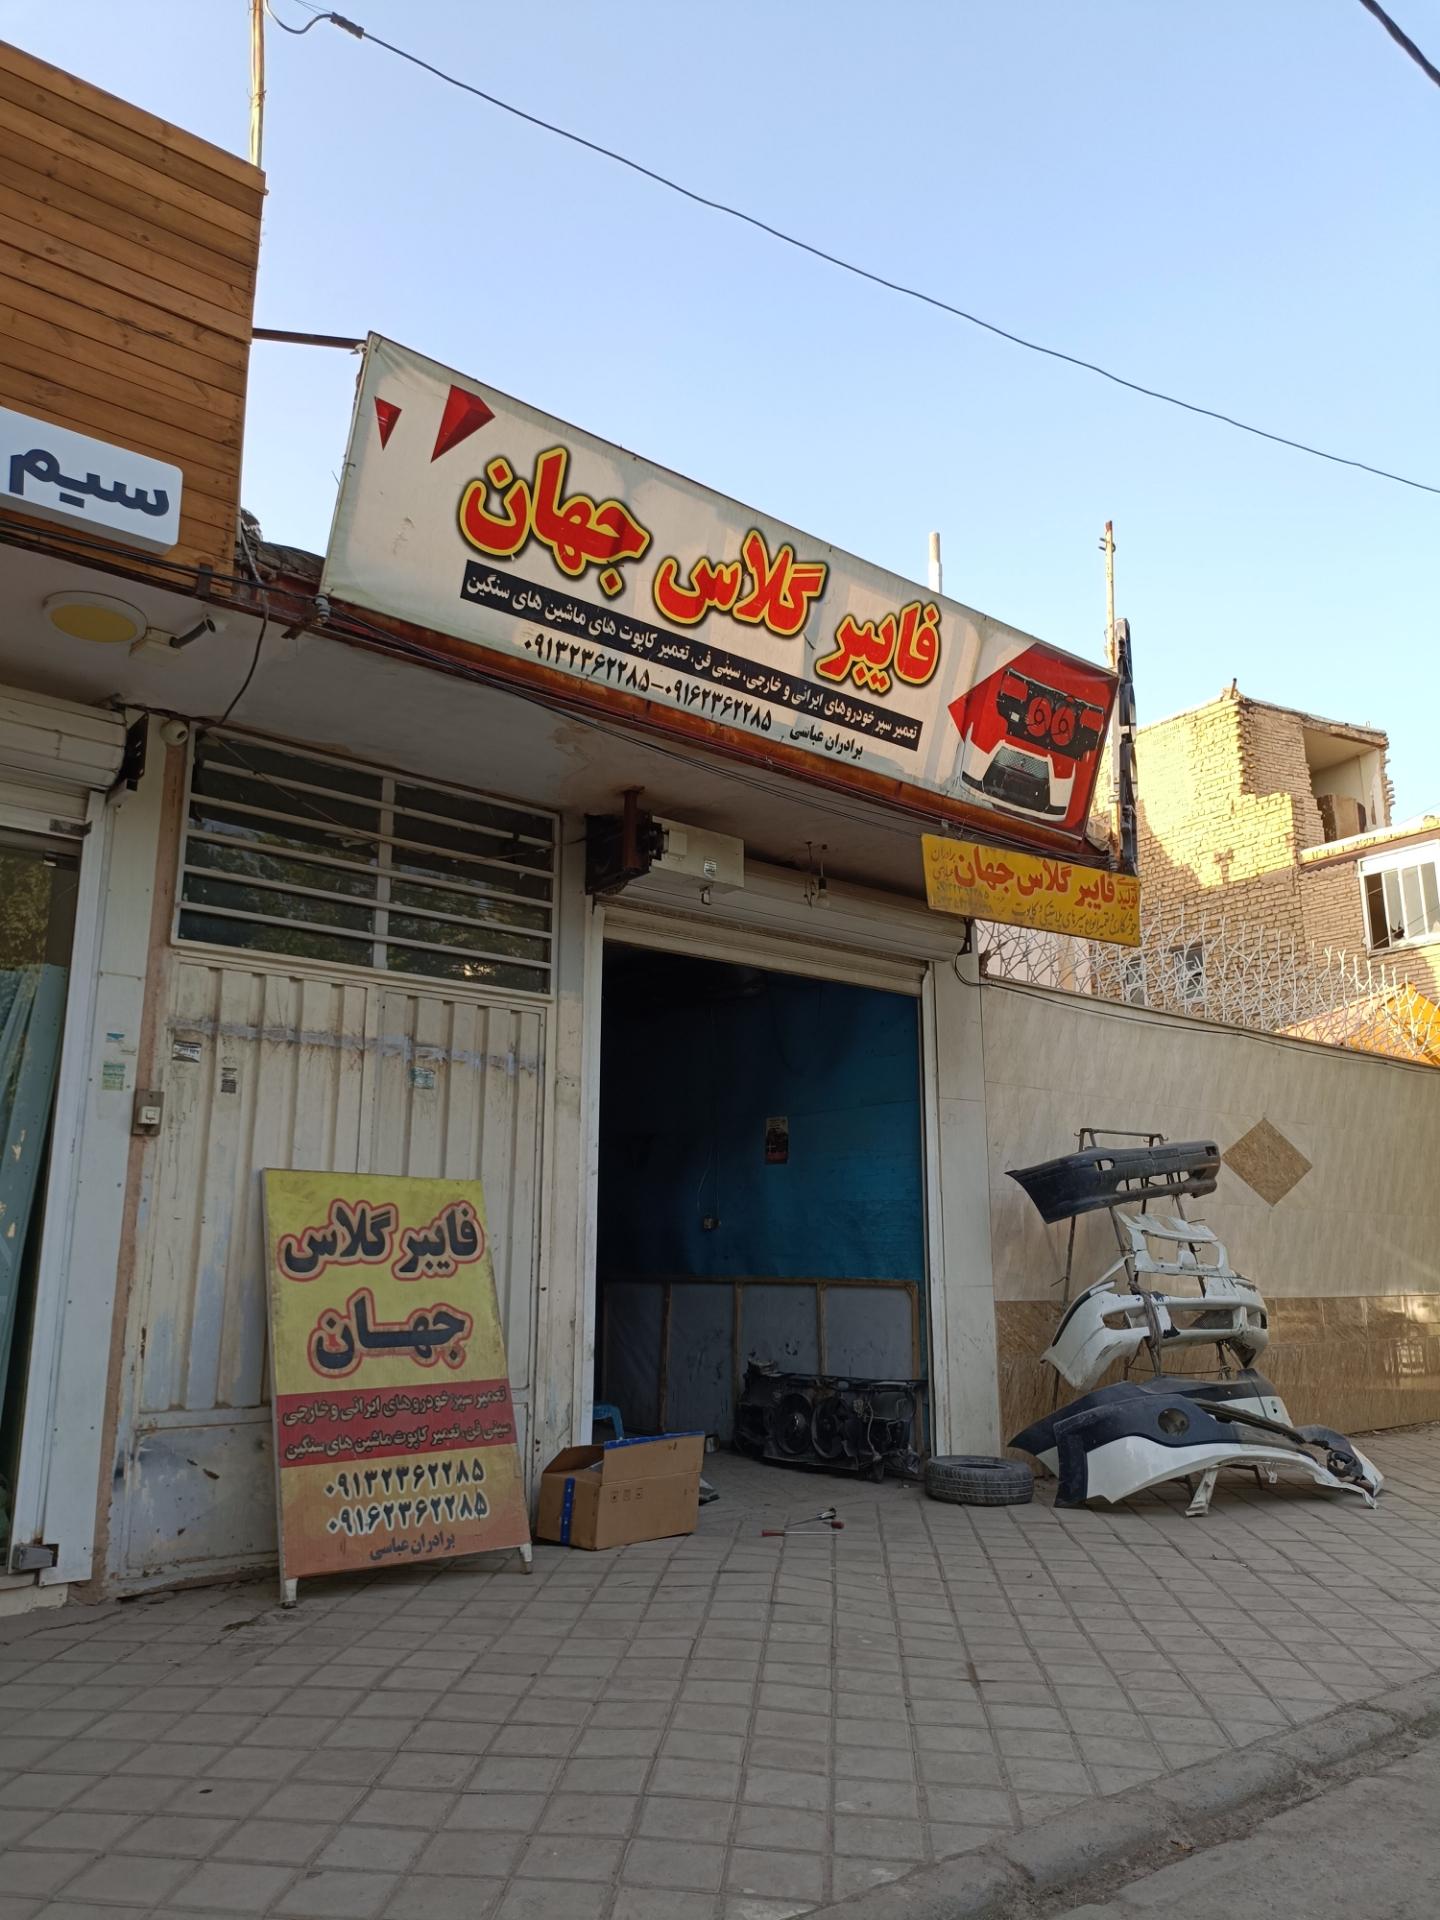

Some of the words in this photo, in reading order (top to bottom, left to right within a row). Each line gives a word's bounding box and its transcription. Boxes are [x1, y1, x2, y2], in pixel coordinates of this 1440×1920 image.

[9, 449, 169, 516] سیم
[459, 447, 650, 596] جهان
[466, 574, 510, 599] سنگین
[654, 528, 827, 637] گلاس
[512, 590, 542, 610] های
[545, 603, 586, 625] ماشین
[588, 617, 616, 636] های
[619, 625, 658, 653] کاپوت
[816, 600, 941, 693] فایبر
[657, 644, 691, 661] تعمیر
[711, 660, 741, 681] سینی
[783, 685, 790, 700] و
[791, 686, 824, 710] ایرانی
[824, 699, 875, 727] خودروهای
[789, 724, 824, 742] عباسی
[874, 721, 892, 736] سپر
[893, 726, 918, 740] تعمیر
[824, 734, 864, 760] برادران
[954, 846, 1014, 894] جهان
[1017, 859, 1072, 896] گلاس
[1074, 872, 1115, 910] فایبر
[281, 1201, 394, 1278] گلاس
[394, 1203, 482, 1277] فایبر
[312, 1292, 468, 1373] جهان
[340, 1395, 380, 1420] ایرانی
[382, 1391, 449, 1417] خودروهای
[475, 1386, 506, 1408] تعمیر
[283, 1400, 329, 1426] خارجی
[330, 1404, 339, 1421] و
[354, 1430, 392, 1453] ماشین
[393, 1425, 429, 1449] کاپوت
[431, 1423, 460, 1446] تعمیر
[483, 1421, 511, 1440] سینی
[286, 1434, 325, 1460] سنگین
[326, 1435, 353, 1456] های
[326, 1457, 485, 1498] ۰۹۱۳۲۳۶۲۲۸۵
[327, 1491, 488, 1534] ۰۹۱۶۲۳۶۲۲۸۵
[370, 1537, 409, 1560] عباسی
[411, 1531, 455, 1554] برادران
